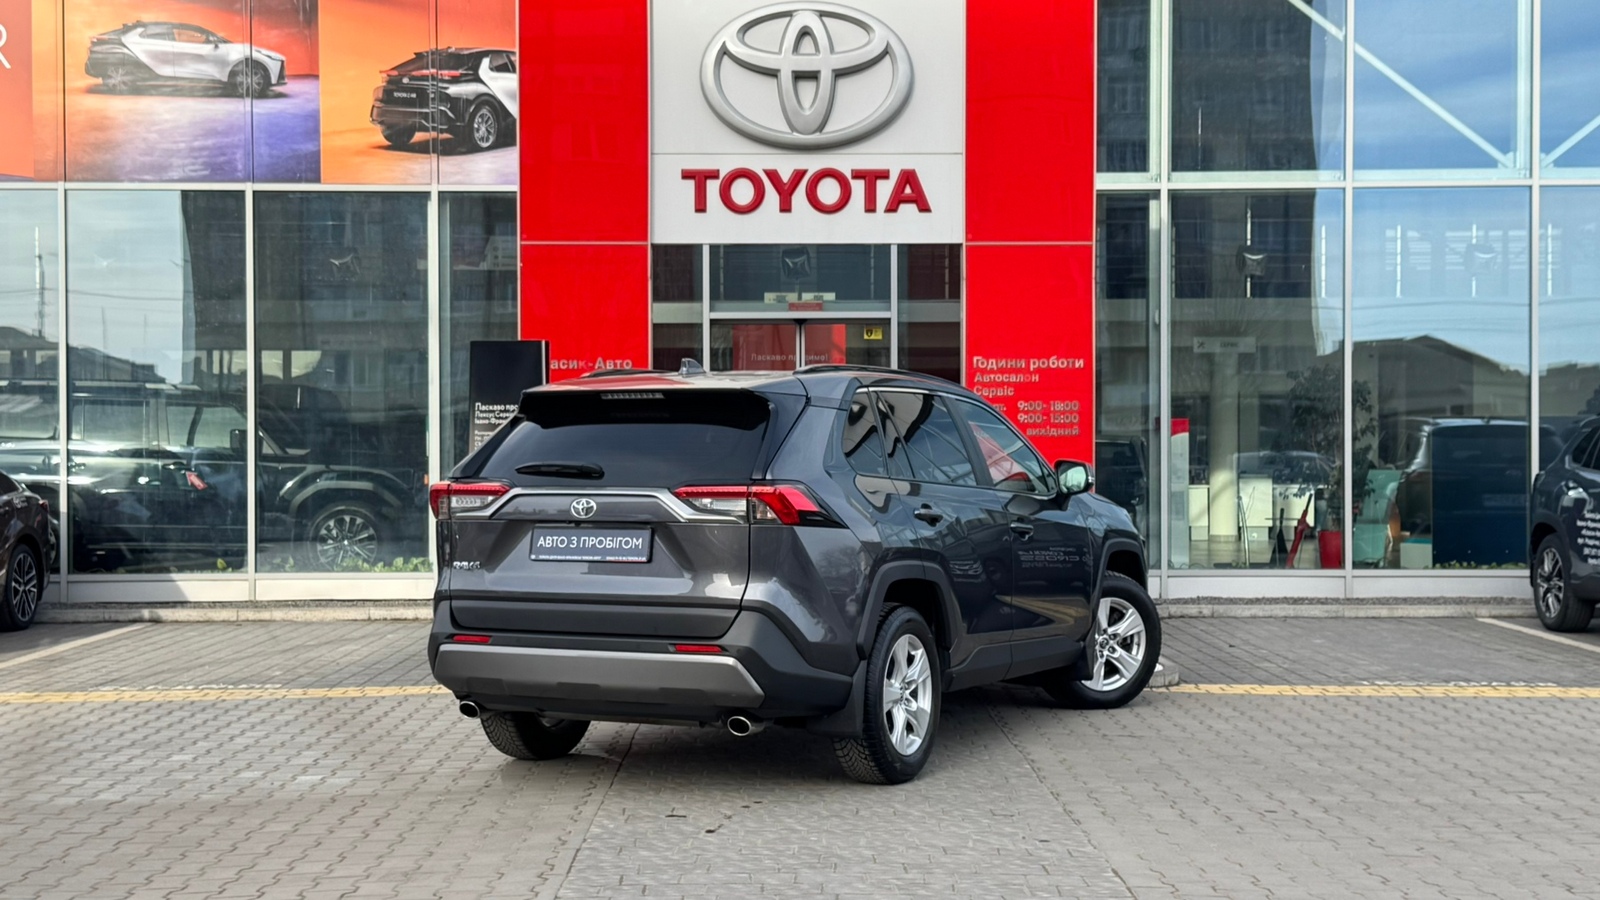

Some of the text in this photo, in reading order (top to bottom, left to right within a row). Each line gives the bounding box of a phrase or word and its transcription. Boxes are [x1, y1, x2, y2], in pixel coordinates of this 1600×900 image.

[681, 167, 932, 214] TOYOTA
[751, 353, 786, 361] Ласкаво
[973, 355, 1084, 371] Години роботи
[974, 373, 1039, 382] Автосалон
[973, 385, 1015, 398] Сервіс
[1027, 427, 1079, 436] вихідний
[537, 536, 567, 548] АВТО
[580, 536, 642, 549] ПРОБІГОМ
